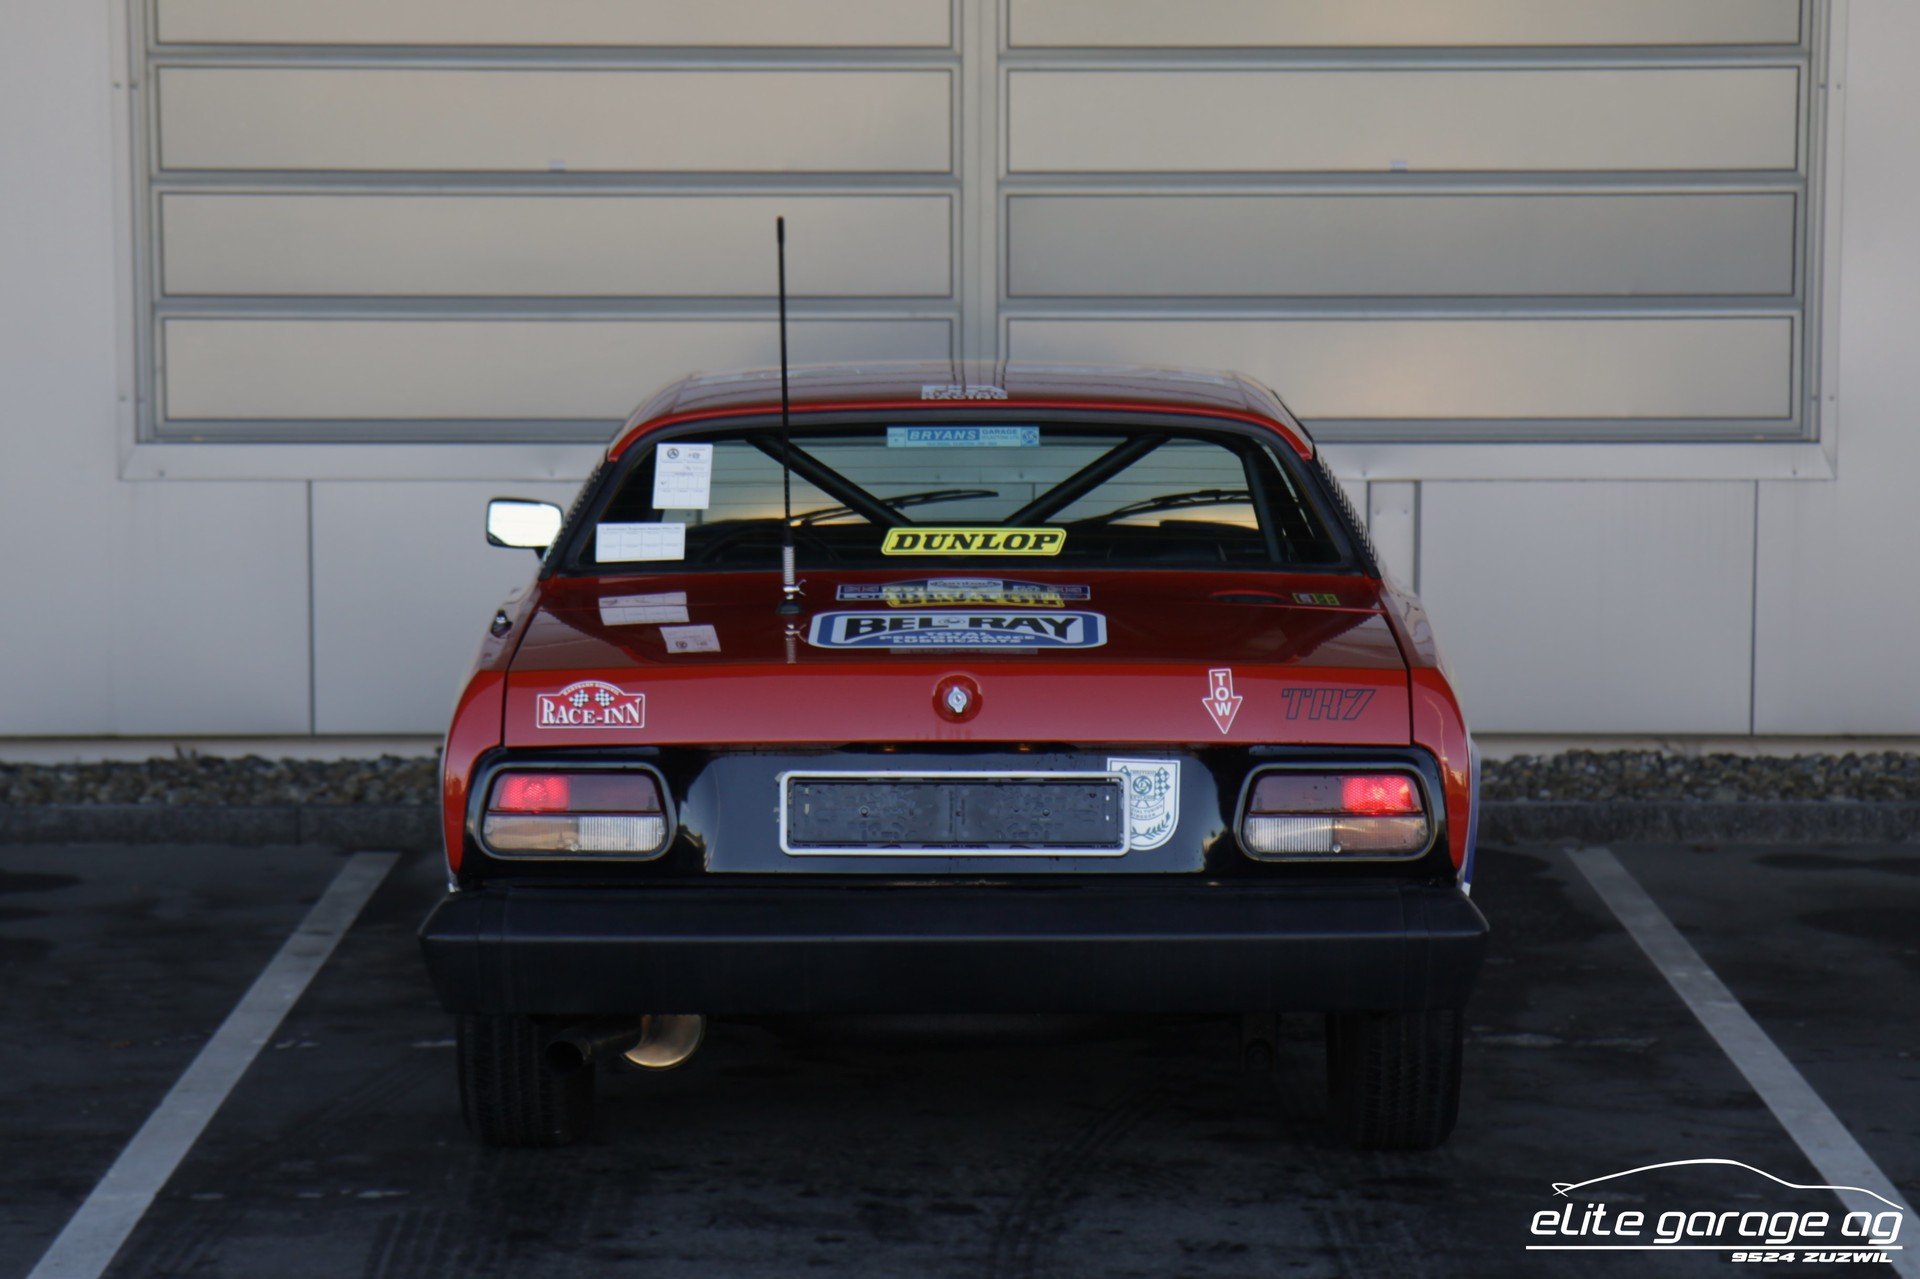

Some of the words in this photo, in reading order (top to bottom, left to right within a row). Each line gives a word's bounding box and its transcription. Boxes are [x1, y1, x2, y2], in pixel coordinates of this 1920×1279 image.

[910, 430, 976, 440] BRYANS
[891, 534, 1059, 550] DUNLOP
[1214, 672, 1232, 716] TOW
[1281, 688, 1376, 720] TR7
[542, 698, 641, 724] RACE-INN
